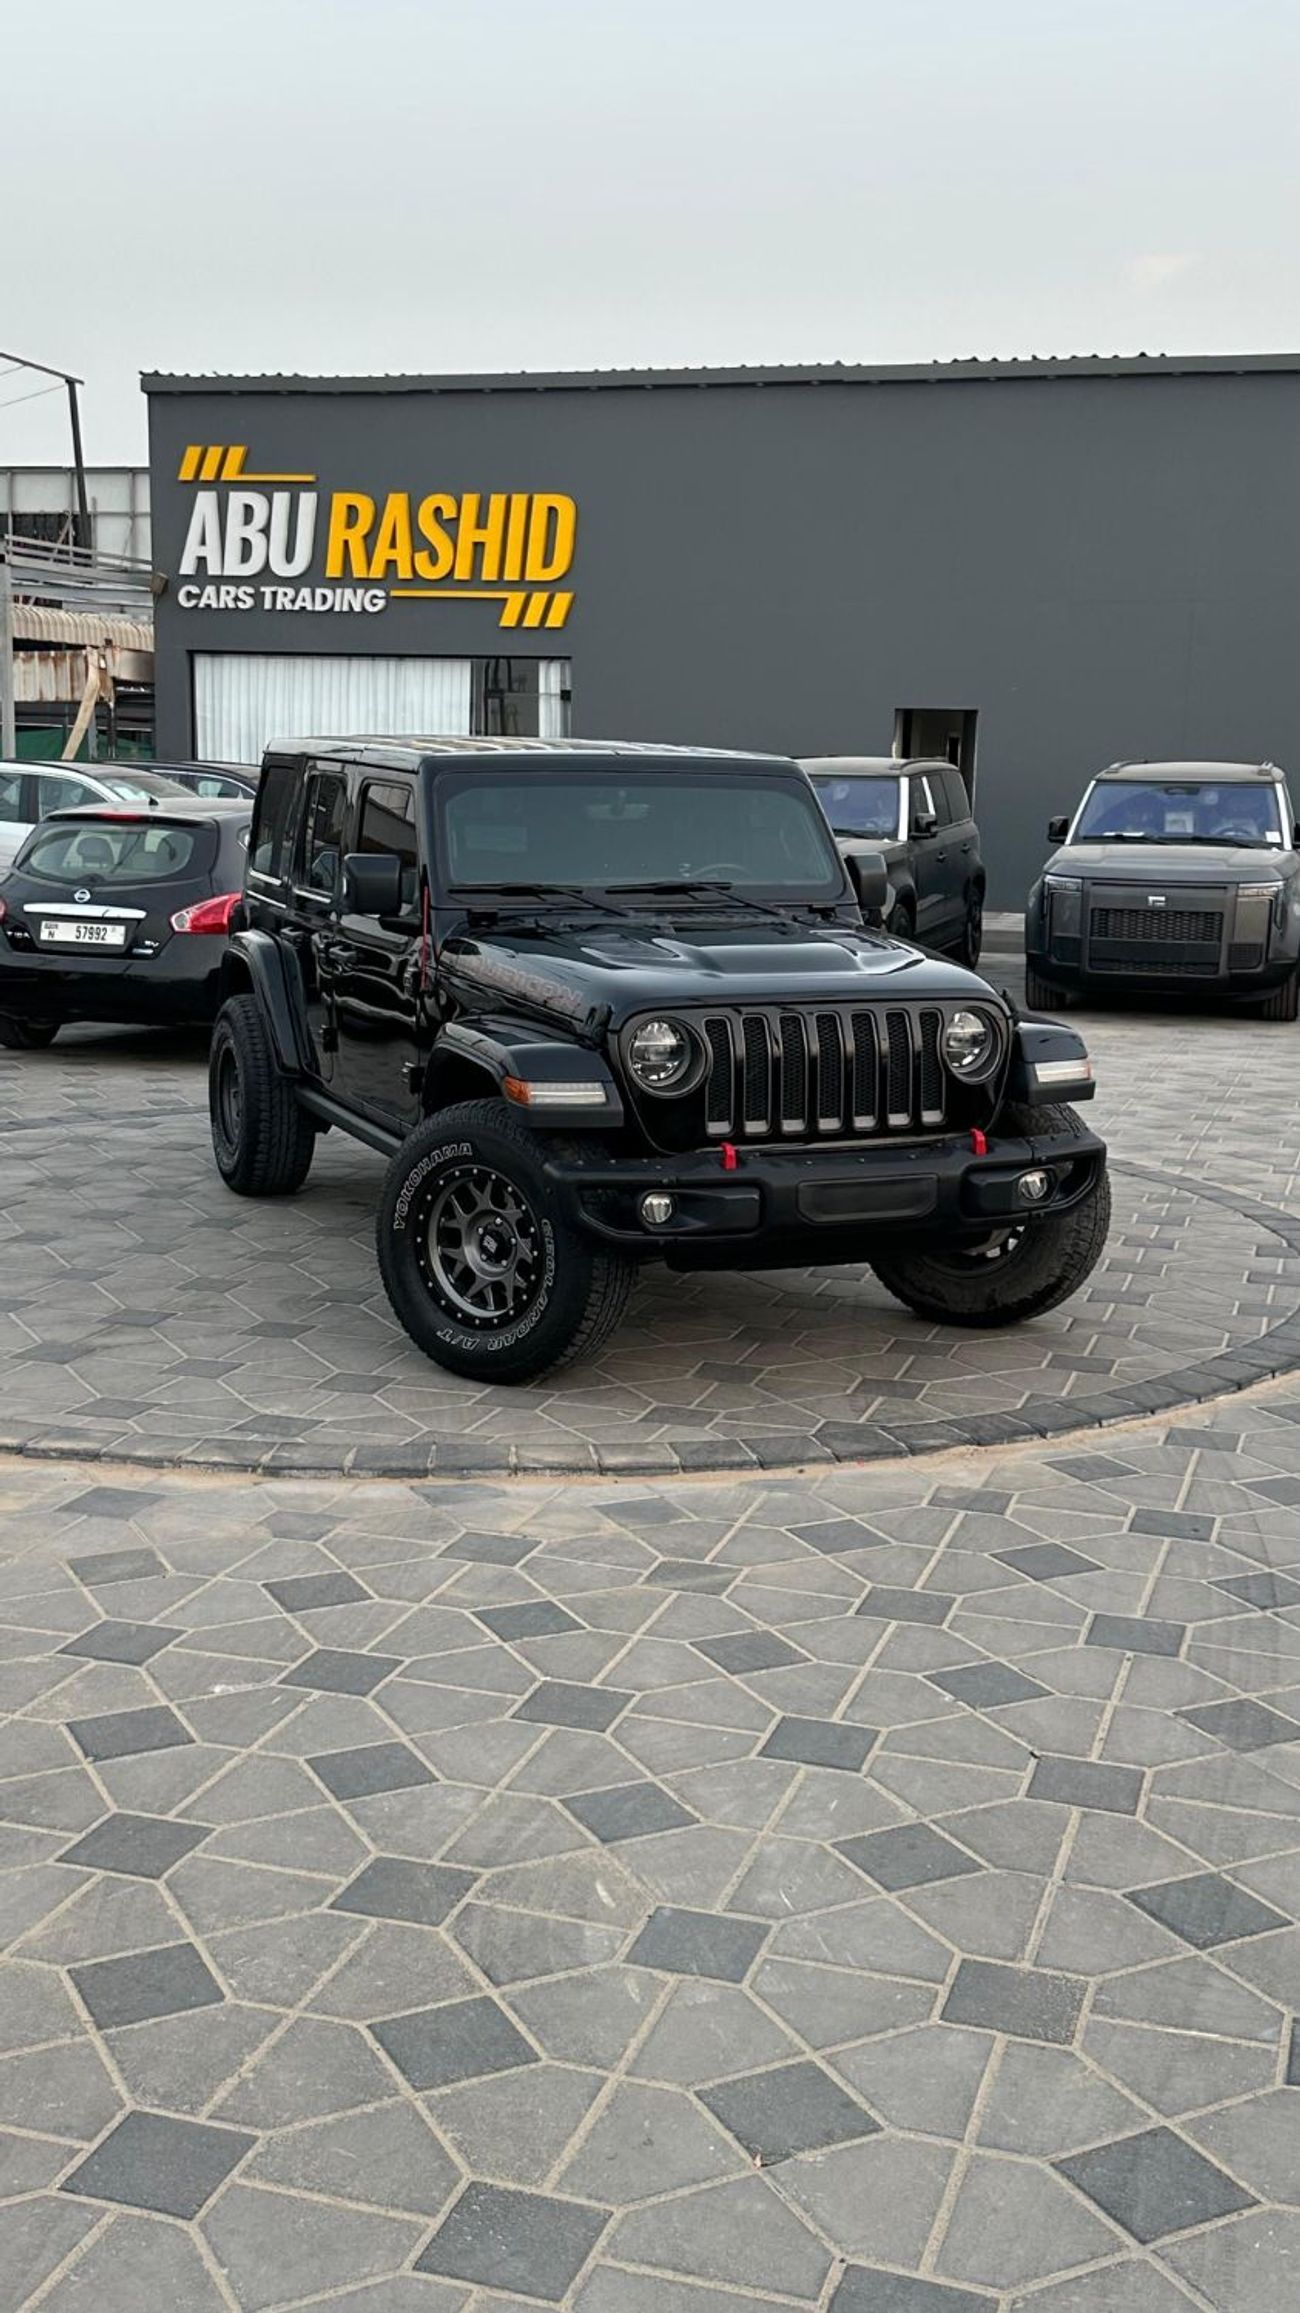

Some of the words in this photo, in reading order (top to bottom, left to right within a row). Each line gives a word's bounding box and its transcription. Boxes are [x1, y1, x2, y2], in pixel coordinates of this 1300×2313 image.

[179, 491, 317, 577] ABU
[325, 492, 577, 582] RASHID
[177, 585, 255, 609] CARS
[260, 586, 386, 612] TRADING
[75, 925, 108, 941] 57992
[393, 1142, 473, 1230] YOKOHAMA
